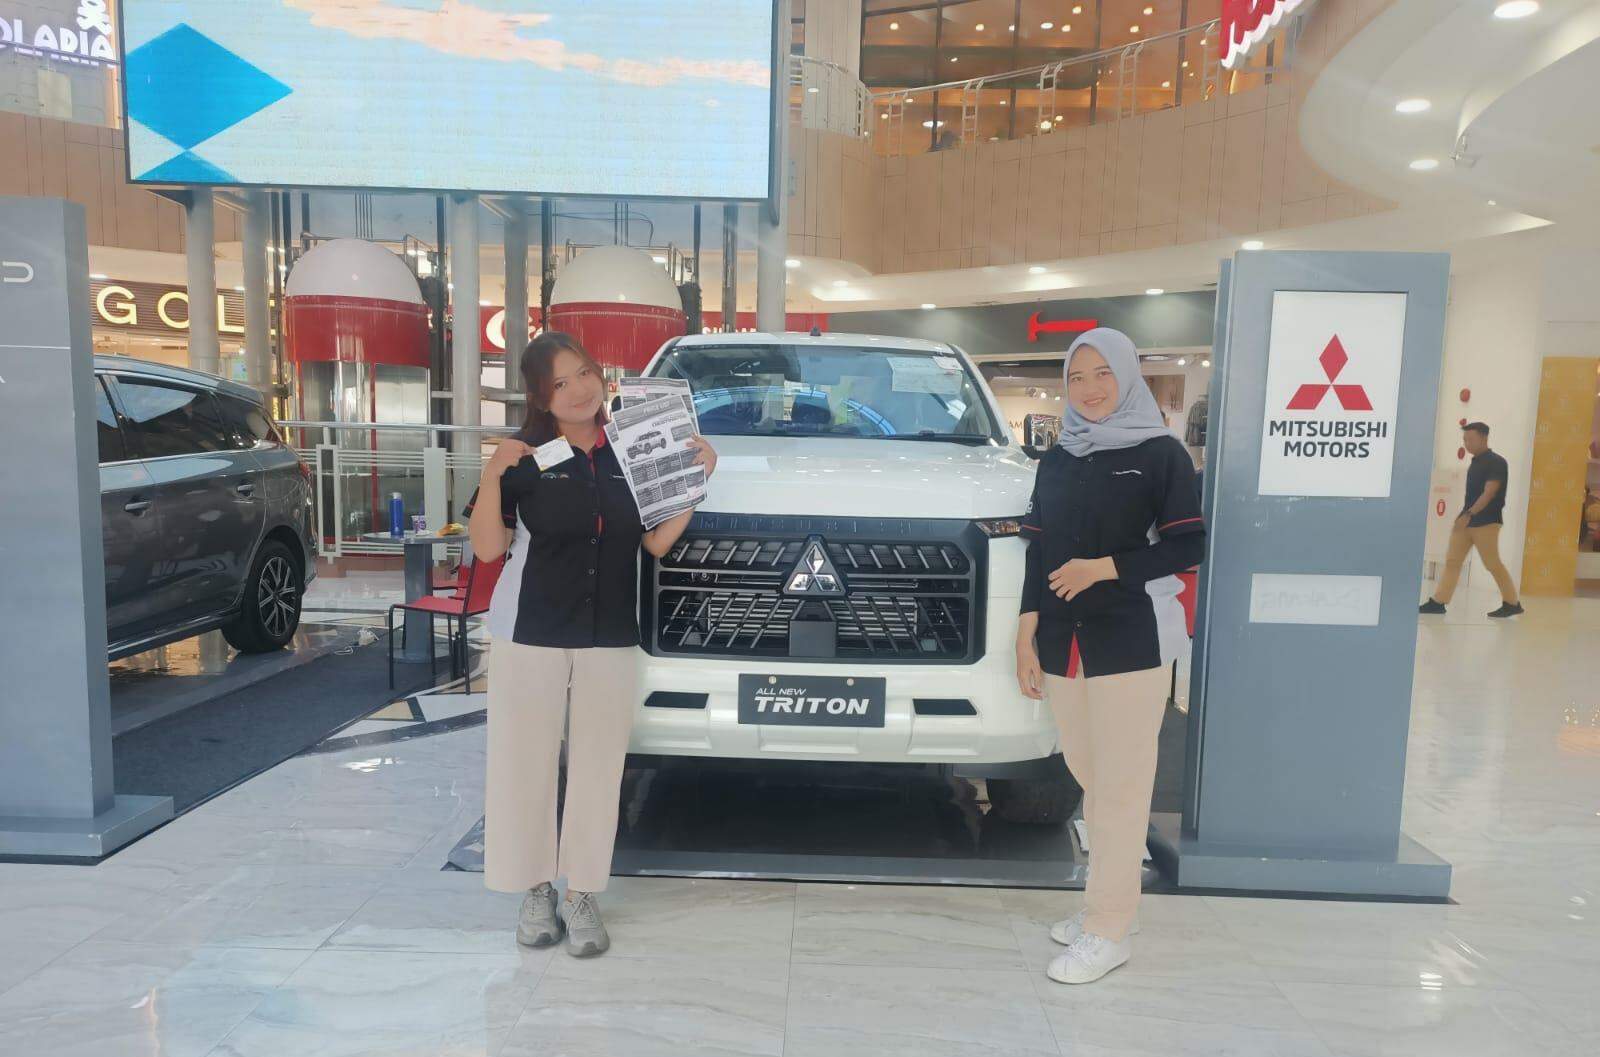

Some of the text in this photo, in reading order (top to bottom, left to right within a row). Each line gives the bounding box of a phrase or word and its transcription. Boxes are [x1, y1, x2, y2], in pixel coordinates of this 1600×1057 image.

[1269, 420, 1387, 438] MITSUBISHI
[1283, 441, 1370, 458] MOTORS
[755, 687, 807, 696] ALL NEW
[754, 696, 870, 715] TRITON
